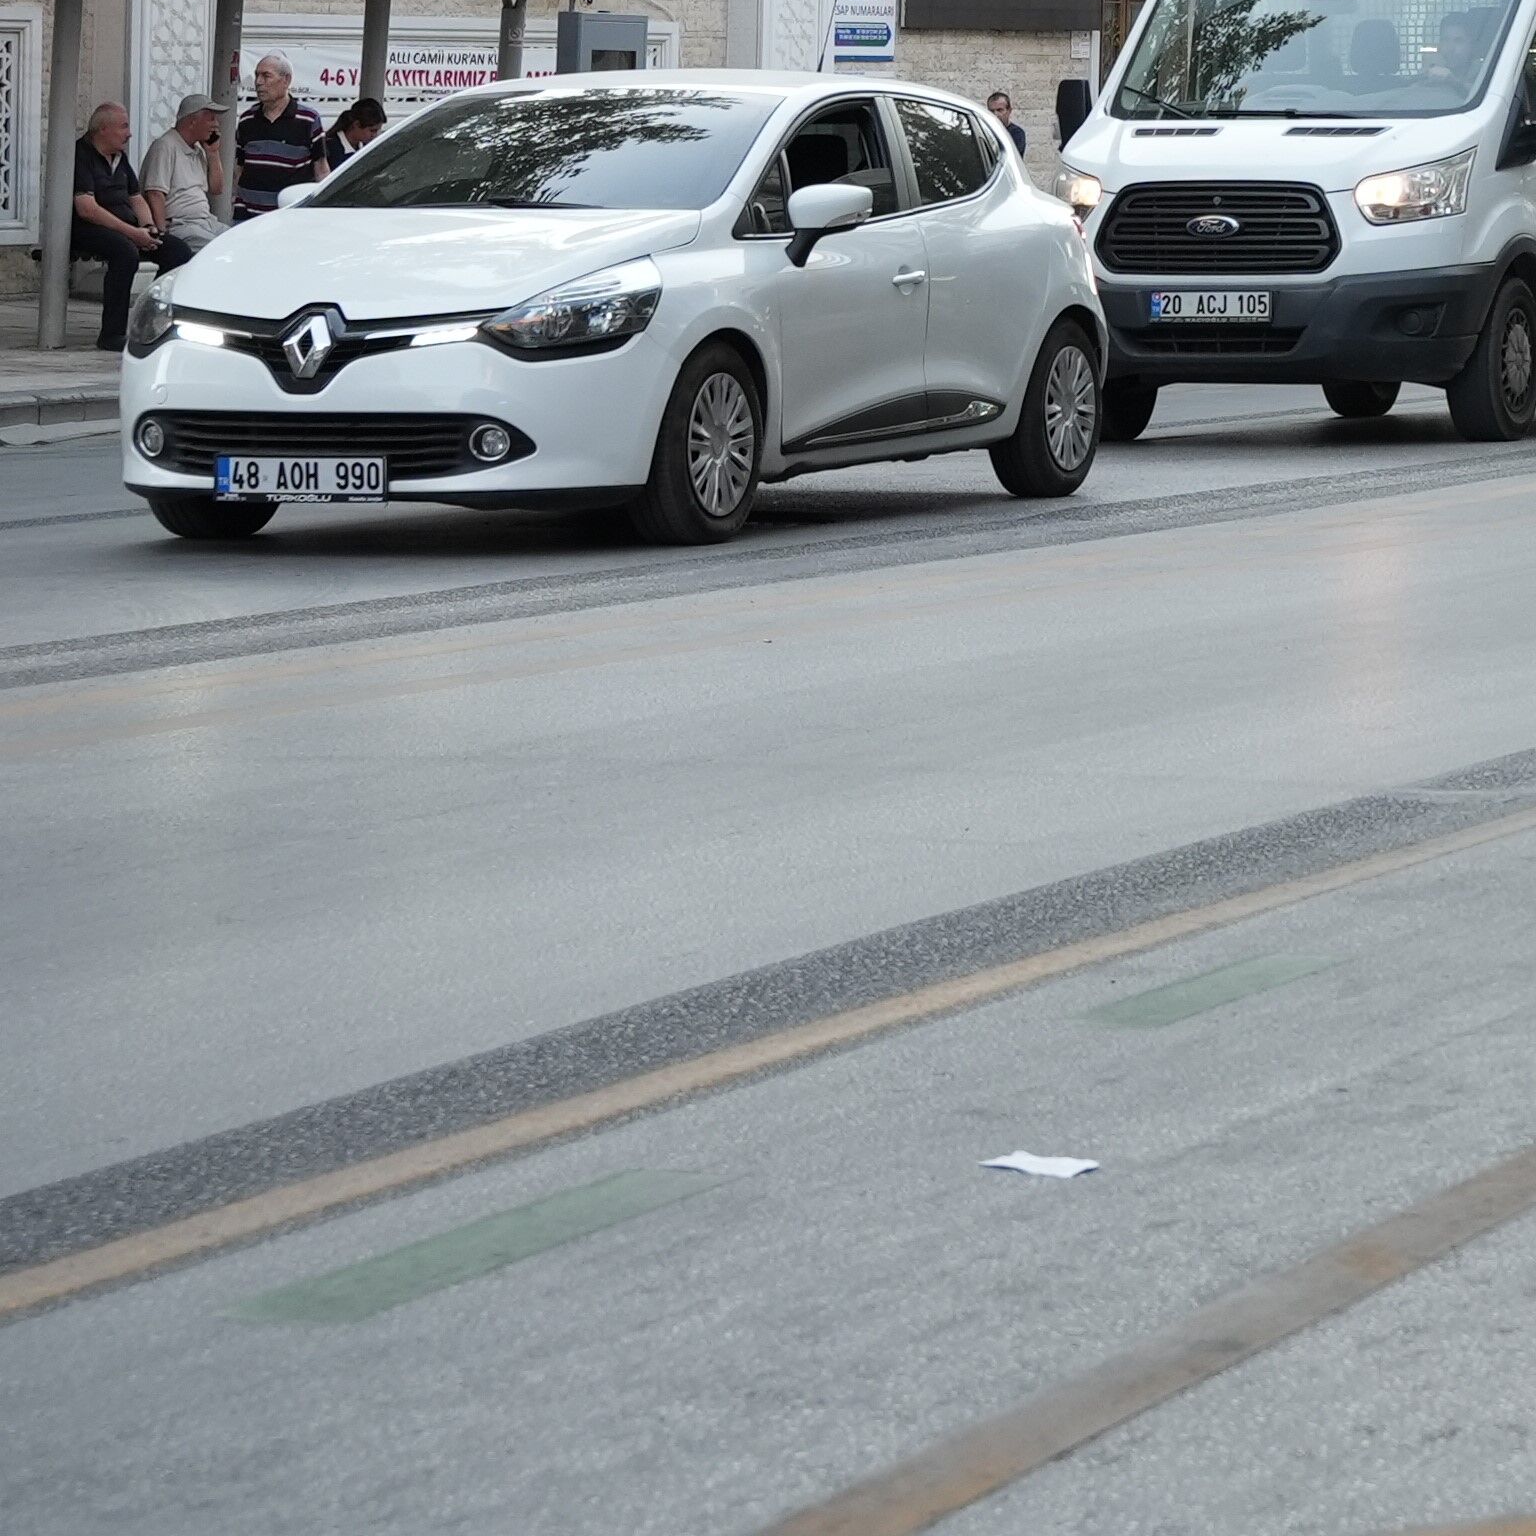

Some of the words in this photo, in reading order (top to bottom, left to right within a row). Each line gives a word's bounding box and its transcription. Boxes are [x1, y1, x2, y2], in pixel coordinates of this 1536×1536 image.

[850, 5, 894, 17] NUMARALARI
[389, 51, 411, 65] ALLI
[413, 49, 444, 66] CAMİİ
[447, 50, 485, 66] KUR'AN
[319, 68, 345, 85] 4-6
[1196, 220, 1226, 233] Ford
[1161, 294, 1182, 315] 20
[1196, 294, 1227, 314] ACJ
[1238, 294, 1267, 314] 105
[232, 461, 260, 489] 48
[276, 461, 319, 490] AOH
[335, 462, 380, 490] 990
[265, 494, 332, 503] TÜRKOĞLU
